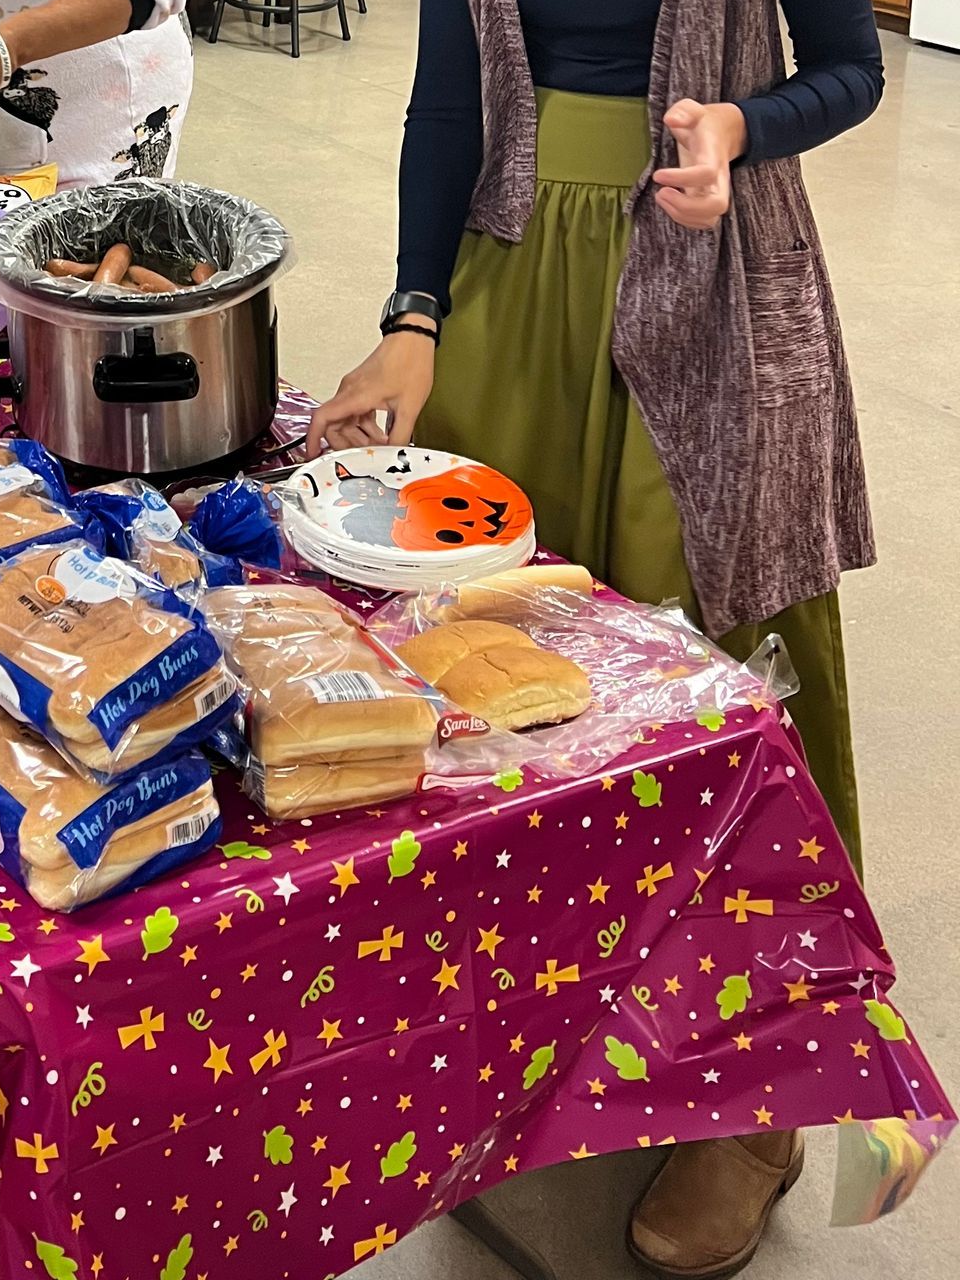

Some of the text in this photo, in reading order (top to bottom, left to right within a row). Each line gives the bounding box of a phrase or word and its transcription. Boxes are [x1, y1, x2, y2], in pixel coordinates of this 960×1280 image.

[67, 555, 88, 574] Hot
[99, 644, 199, 729] Hot Dog Buns
[440, 718, 470, 738] Sara
[71, 768, 178, 849] Hot Dog Buns
